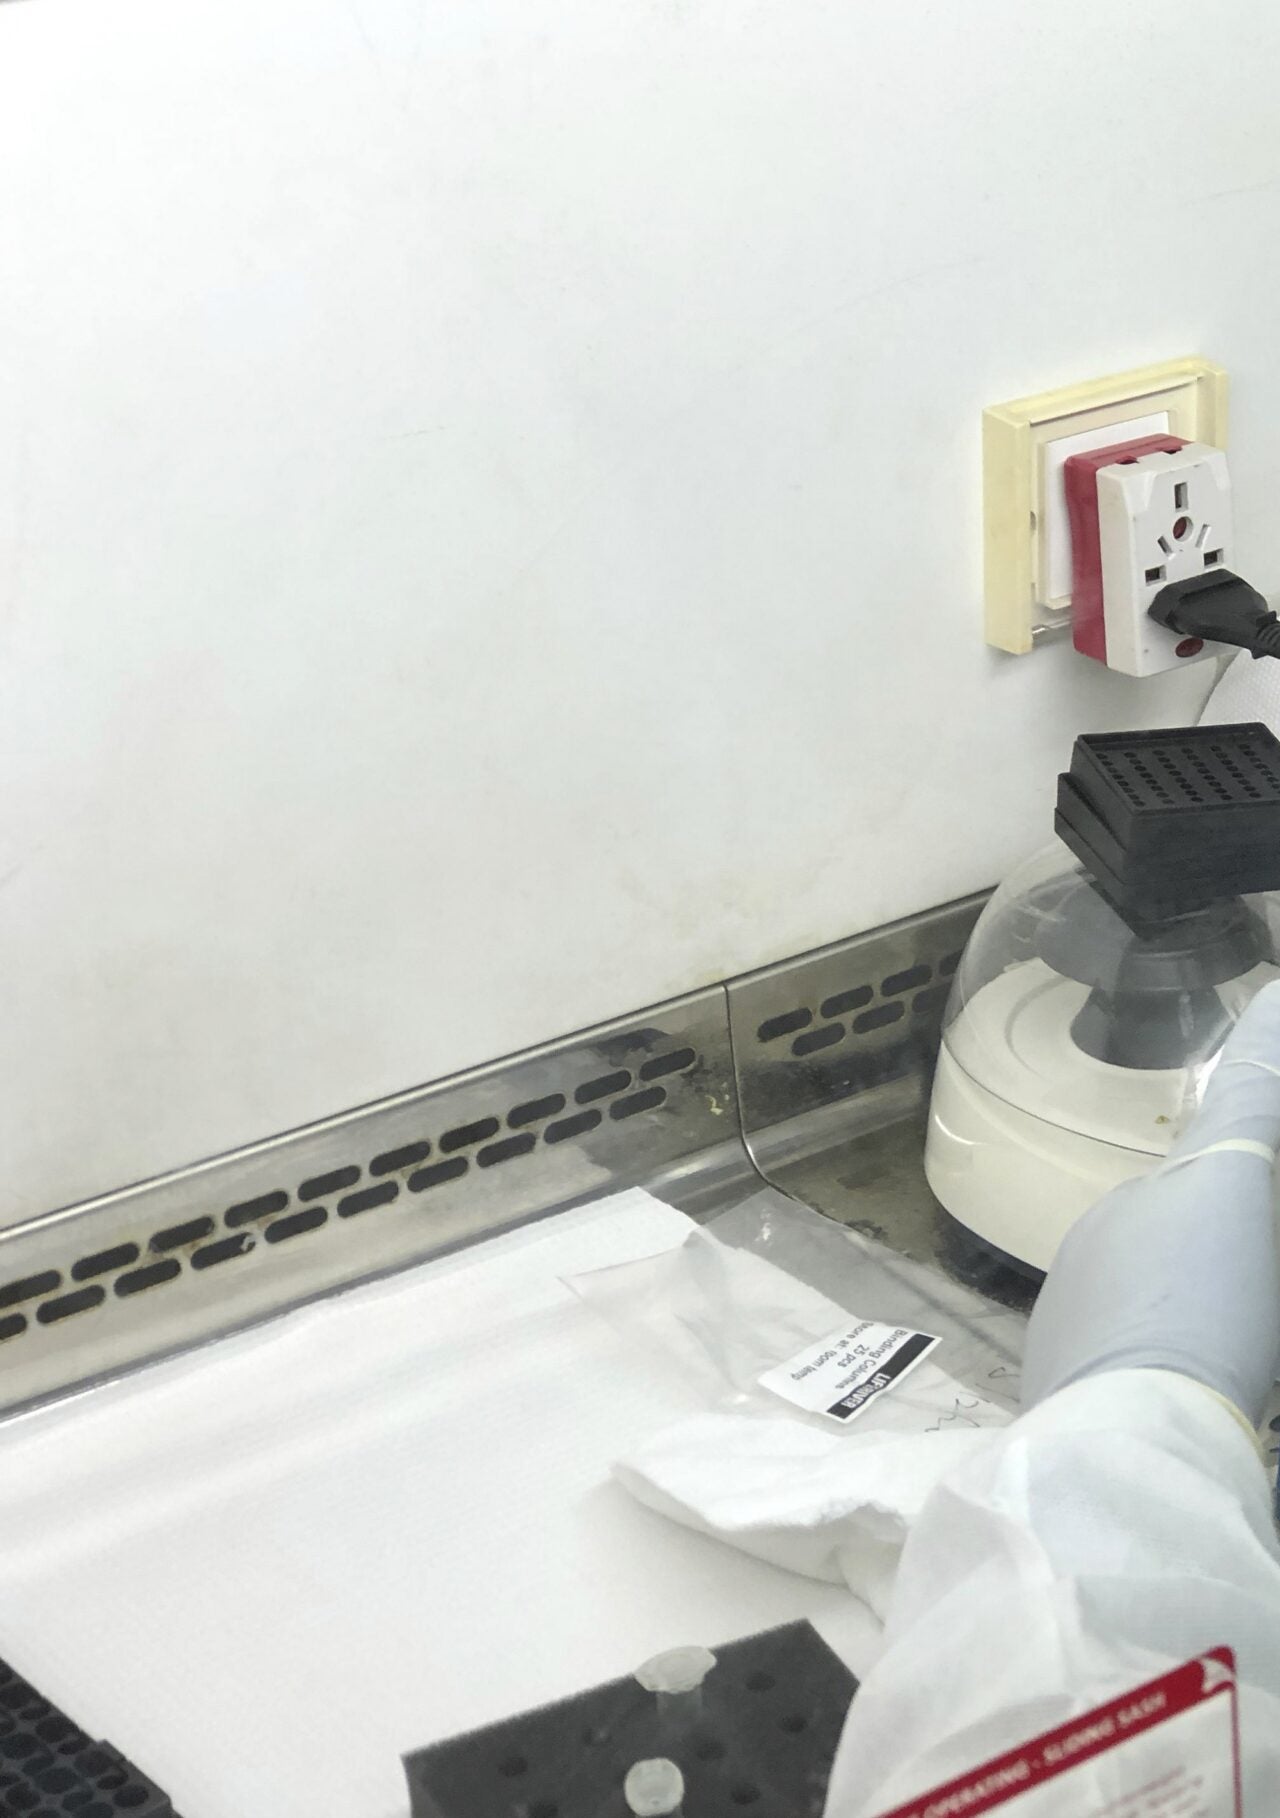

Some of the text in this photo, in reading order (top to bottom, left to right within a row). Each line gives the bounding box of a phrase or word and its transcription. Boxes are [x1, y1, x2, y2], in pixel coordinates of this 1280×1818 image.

[812, 1350, 837, 1367] room
[835, 1329, 908, 1389] Binding Columns
[837, 1344, 870, 1368] 25 pcs
